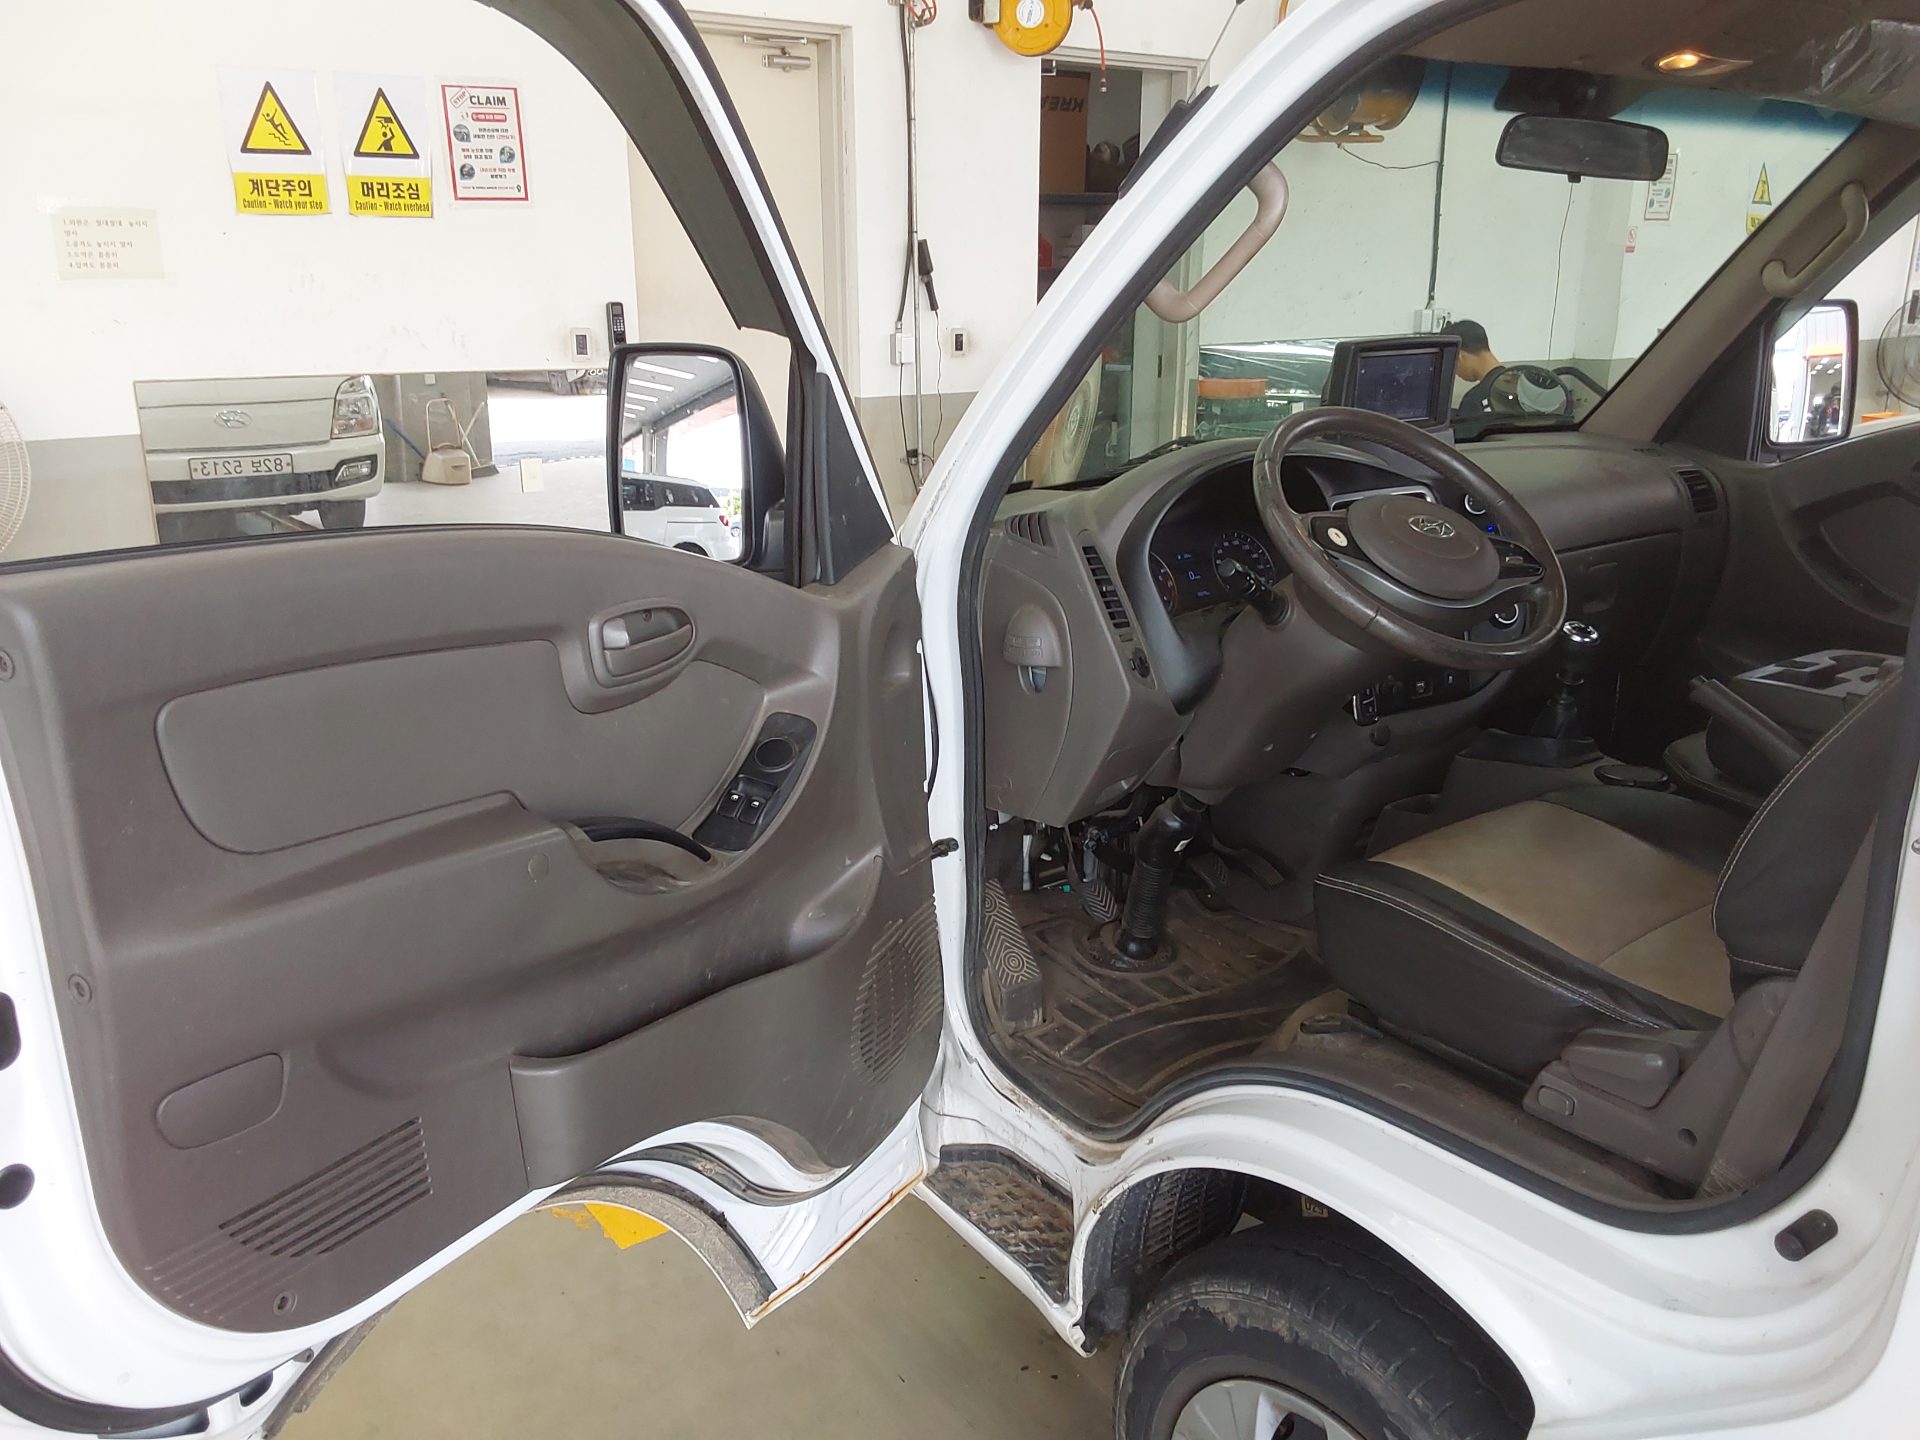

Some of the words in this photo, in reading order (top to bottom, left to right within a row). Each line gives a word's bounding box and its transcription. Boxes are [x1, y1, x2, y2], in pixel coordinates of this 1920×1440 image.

[469, 95, 507, 106] CLAIM
[248, 179, 313, 198] 계단주의
[360, 181, 421, 200] 머리조심
[242, 198, 267, 209] Caution
[273, 199, 293, 210] Watch
[294, 200, 308, 211] your
[309, 199, 323, 211] step
[355, 200, 378, 211] Caution
[383, 201, 402, 212] Watch
[403, 201, 430, 213] overhead
